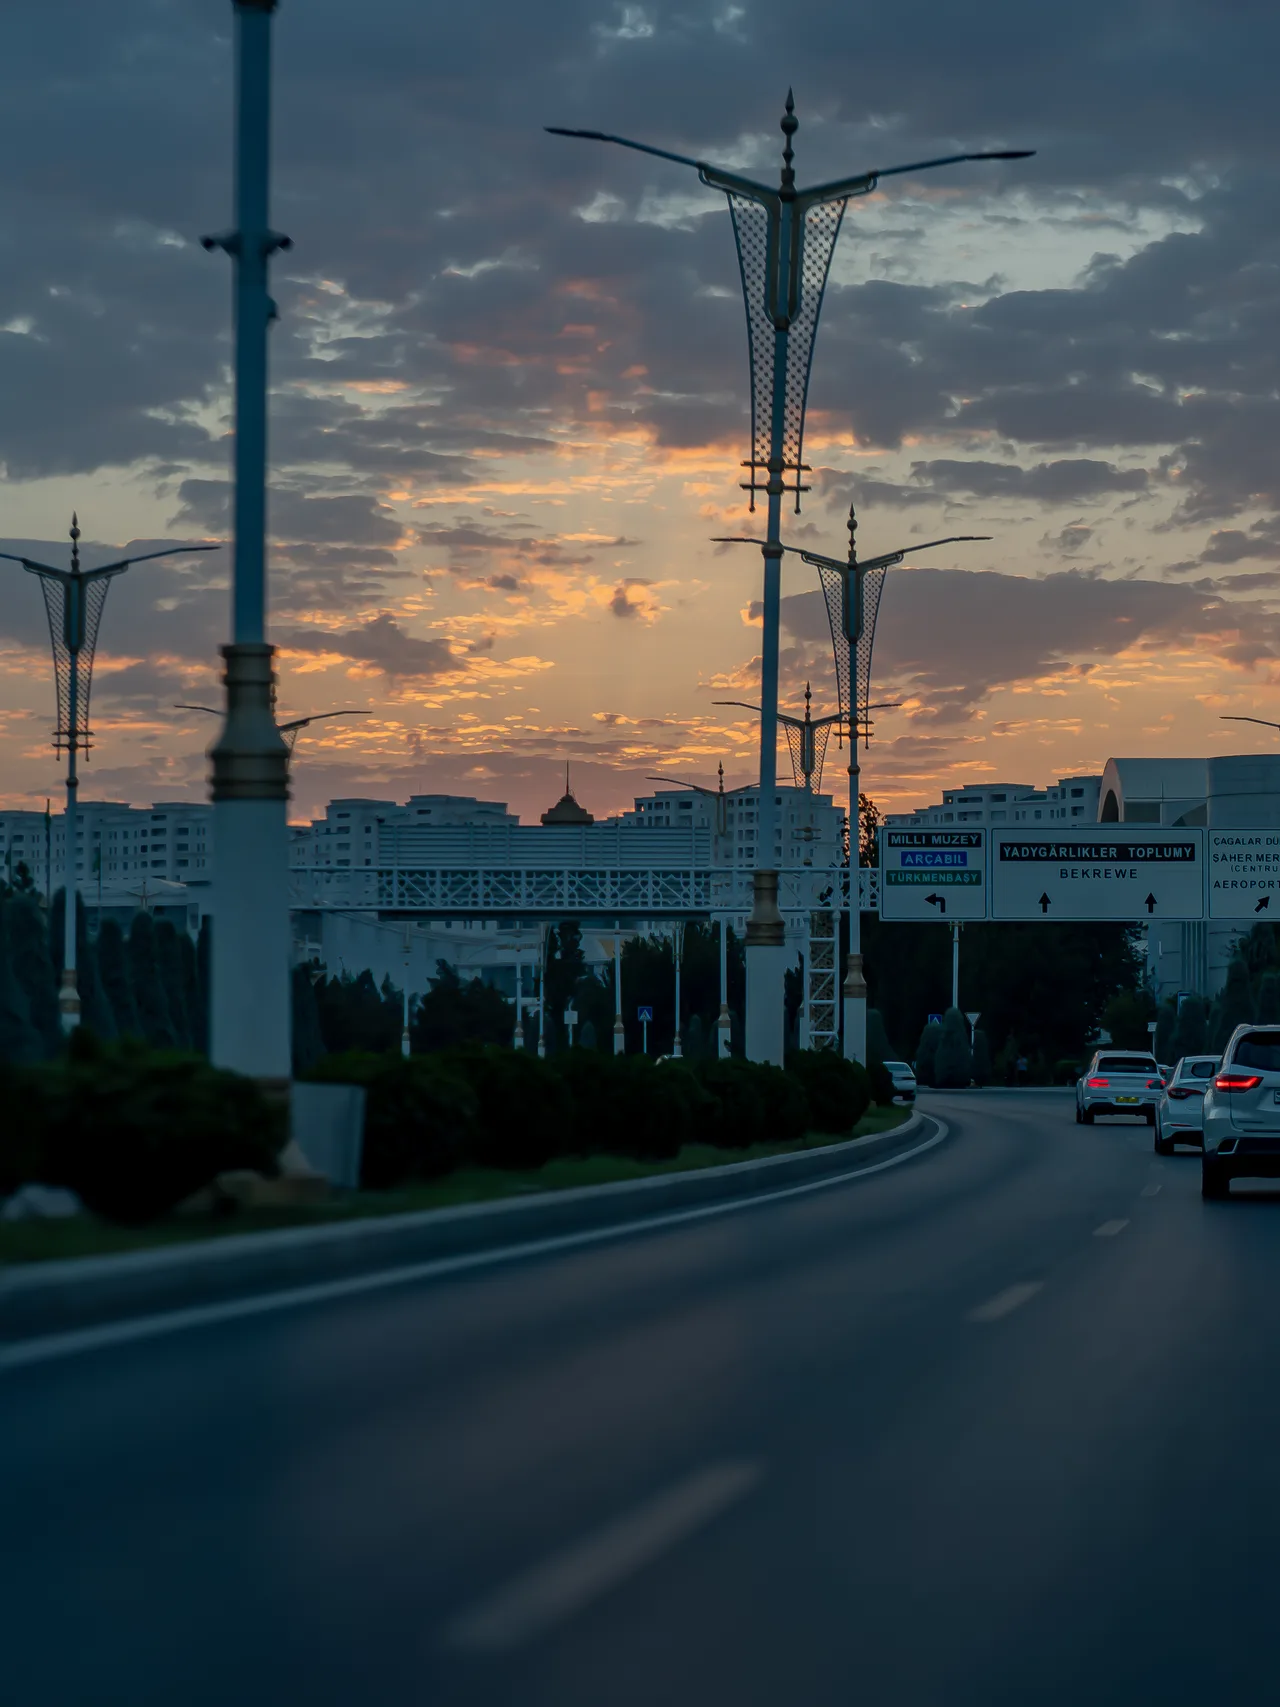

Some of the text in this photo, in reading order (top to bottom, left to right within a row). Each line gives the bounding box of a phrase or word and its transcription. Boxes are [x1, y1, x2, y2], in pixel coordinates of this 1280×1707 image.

[891, 835, 926, 845] MILLI
[1213, 837, 1262, 846] ÇAGALAR
[1128, 847, 1192, 858] TOPLUMY
[1212, 853, 1253, 863] ŞAHER
[904, 854, 964, 866] ARÇABIL
[889, 871, 978, 884] TÜRKMENBAŞY
[1059, 868, 1139, 880] BEKREWE
